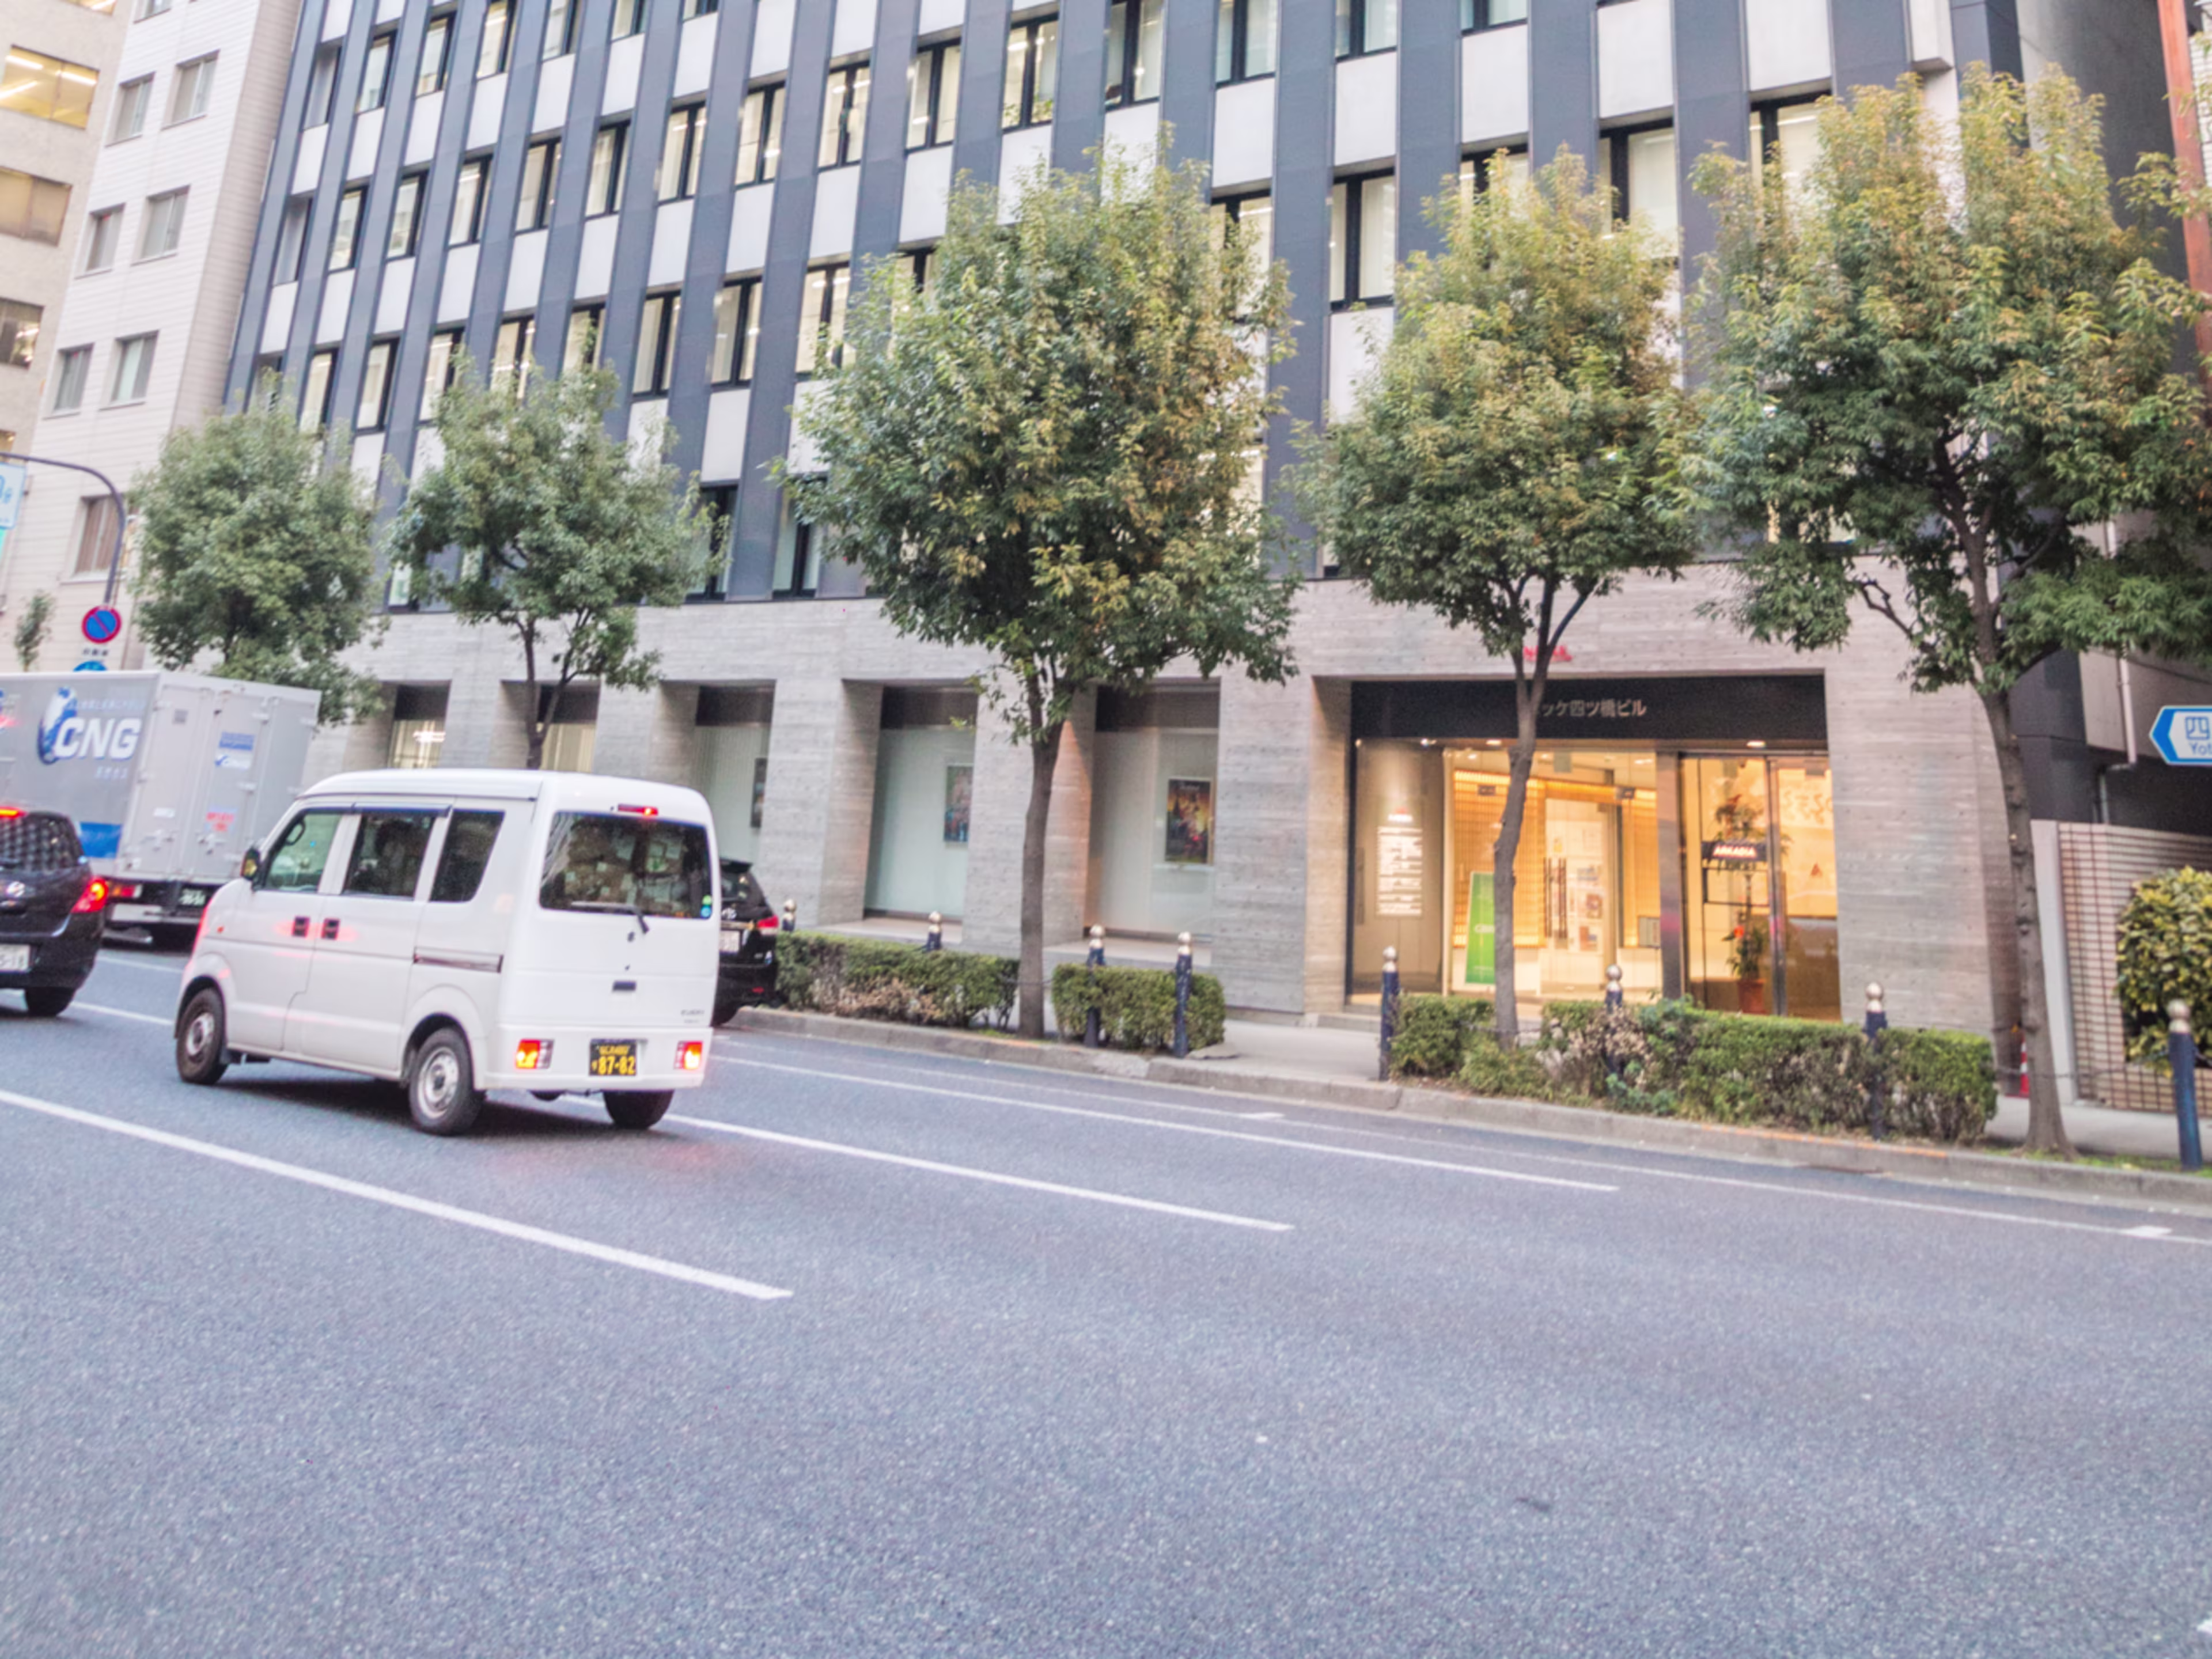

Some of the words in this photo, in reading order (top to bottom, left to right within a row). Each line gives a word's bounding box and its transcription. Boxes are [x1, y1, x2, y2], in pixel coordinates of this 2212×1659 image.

[1537, 699, 1646, 717] ッケ四ツ橋ビル
[54, 717, 142, 761] CNG
[2184, 716, 2210, 741] 四
